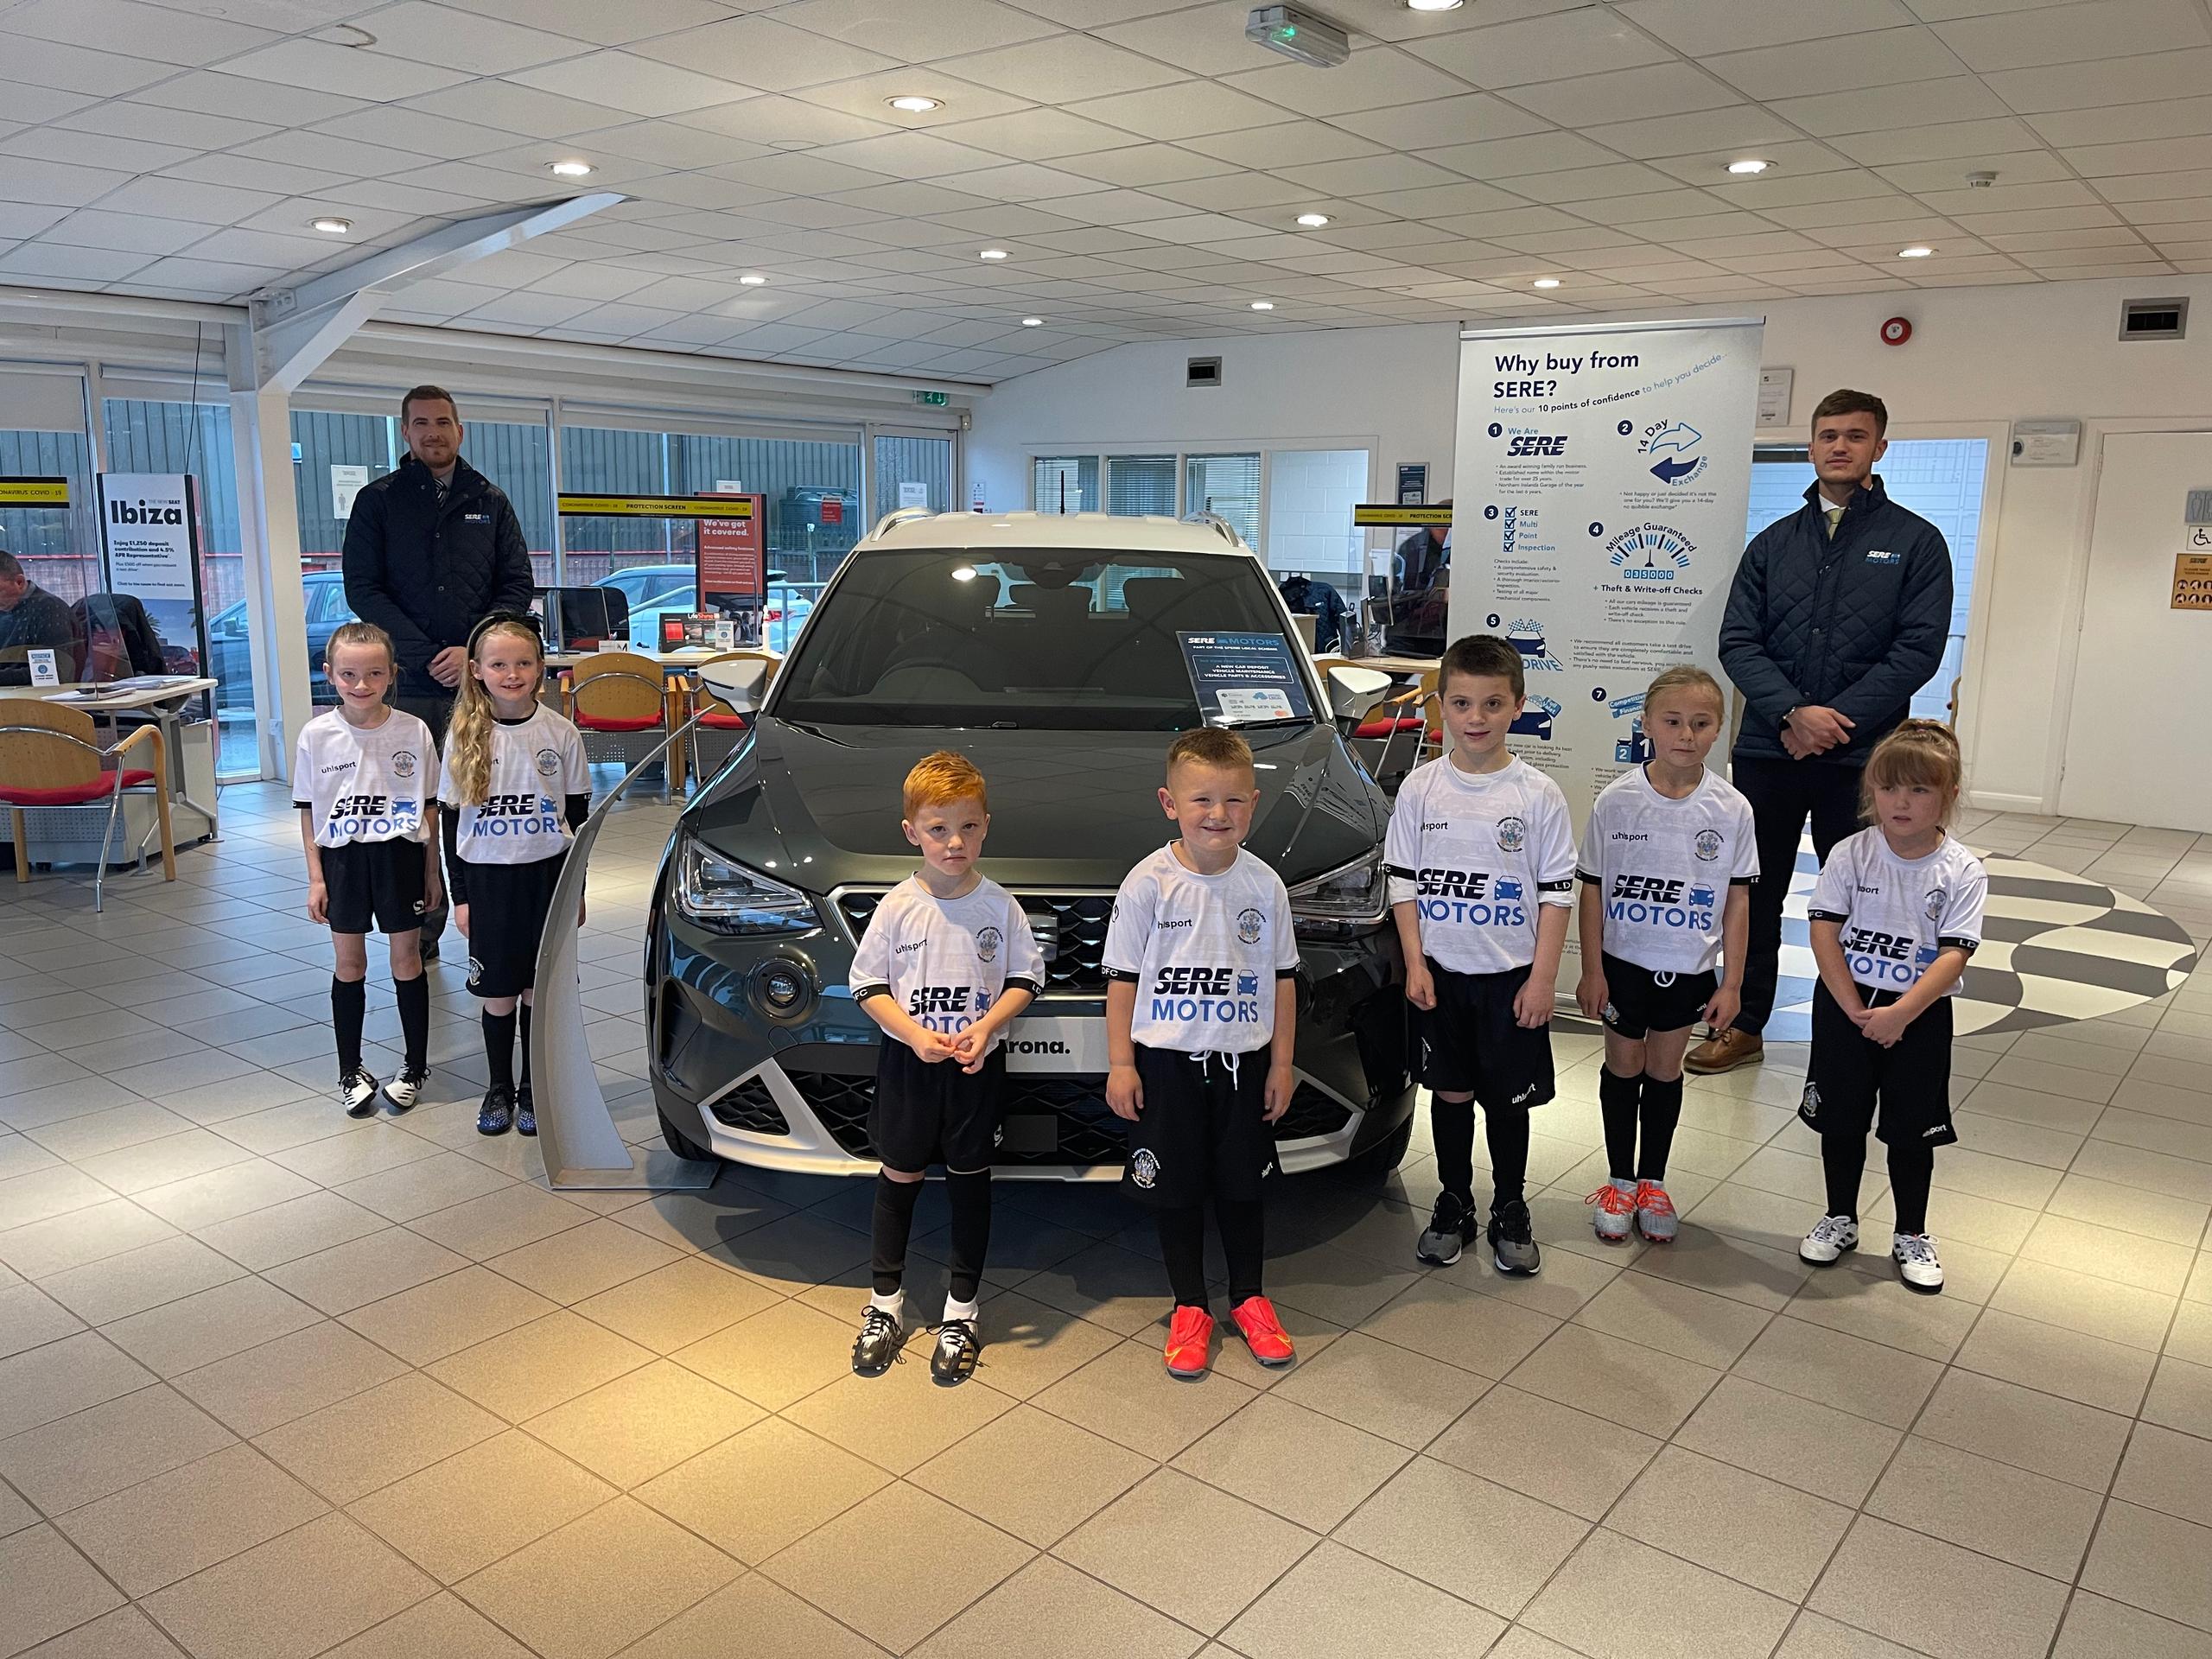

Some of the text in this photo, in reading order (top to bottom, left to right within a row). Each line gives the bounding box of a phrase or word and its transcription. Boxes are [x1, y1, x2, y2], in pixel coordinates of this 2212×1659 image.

[1495, 351, 1639, 376] Why buy from
[1493, 380, 1557, 398] SERE?
[1551, 402, 1578, 413] points
[1580, 398, 1590, 408] of
[1592, 389, 1640, 405] confidence
[1643, 385, 1652, 394] to
[1654, 378, 1673, 389] help
[1675, 372, 1691, 385] you
[1622, 423, 1628, 432] 2
[1638, 419, 1668, 454] 14 Day
[1507, 436, 1567, 456] SERE
[1672, 455, 1707, 486] Exchange
[111, 499, 181, 524] Ibiza
[1592, 523, 1697, 552] 4 Mileage Guaranteed
[1491, 616, 1497, 625] 5
[1619, 749, 1627, 759] 2
[1640, 739, 1649, 757] 1
[321, 761, 356, 773] uhlsport
[329, 817, 417, 838] MOTORS
[473, 817, 563, 838] MOTOR
[1421, 822, 1448, 831] lsport
[1611, 832, 1648, 842] uhlsport
[1417, 868, 1490, 899] SERE
[1554, 881, 1571, 890] LD
[1611, 874, 1685, 904] SERE
[1157, 918, 1192, 930] hlsport
[1605, 902, 1713, 931] MOTORS
[1959, 939, 1976, 949] LD
[1102, 967, 1118, 977] DFC
[1154, 967, 1233, 995] SERE
[909, 986, 971, 1016] SERE
[1152, 999, 1259, 1023] MOTORS
